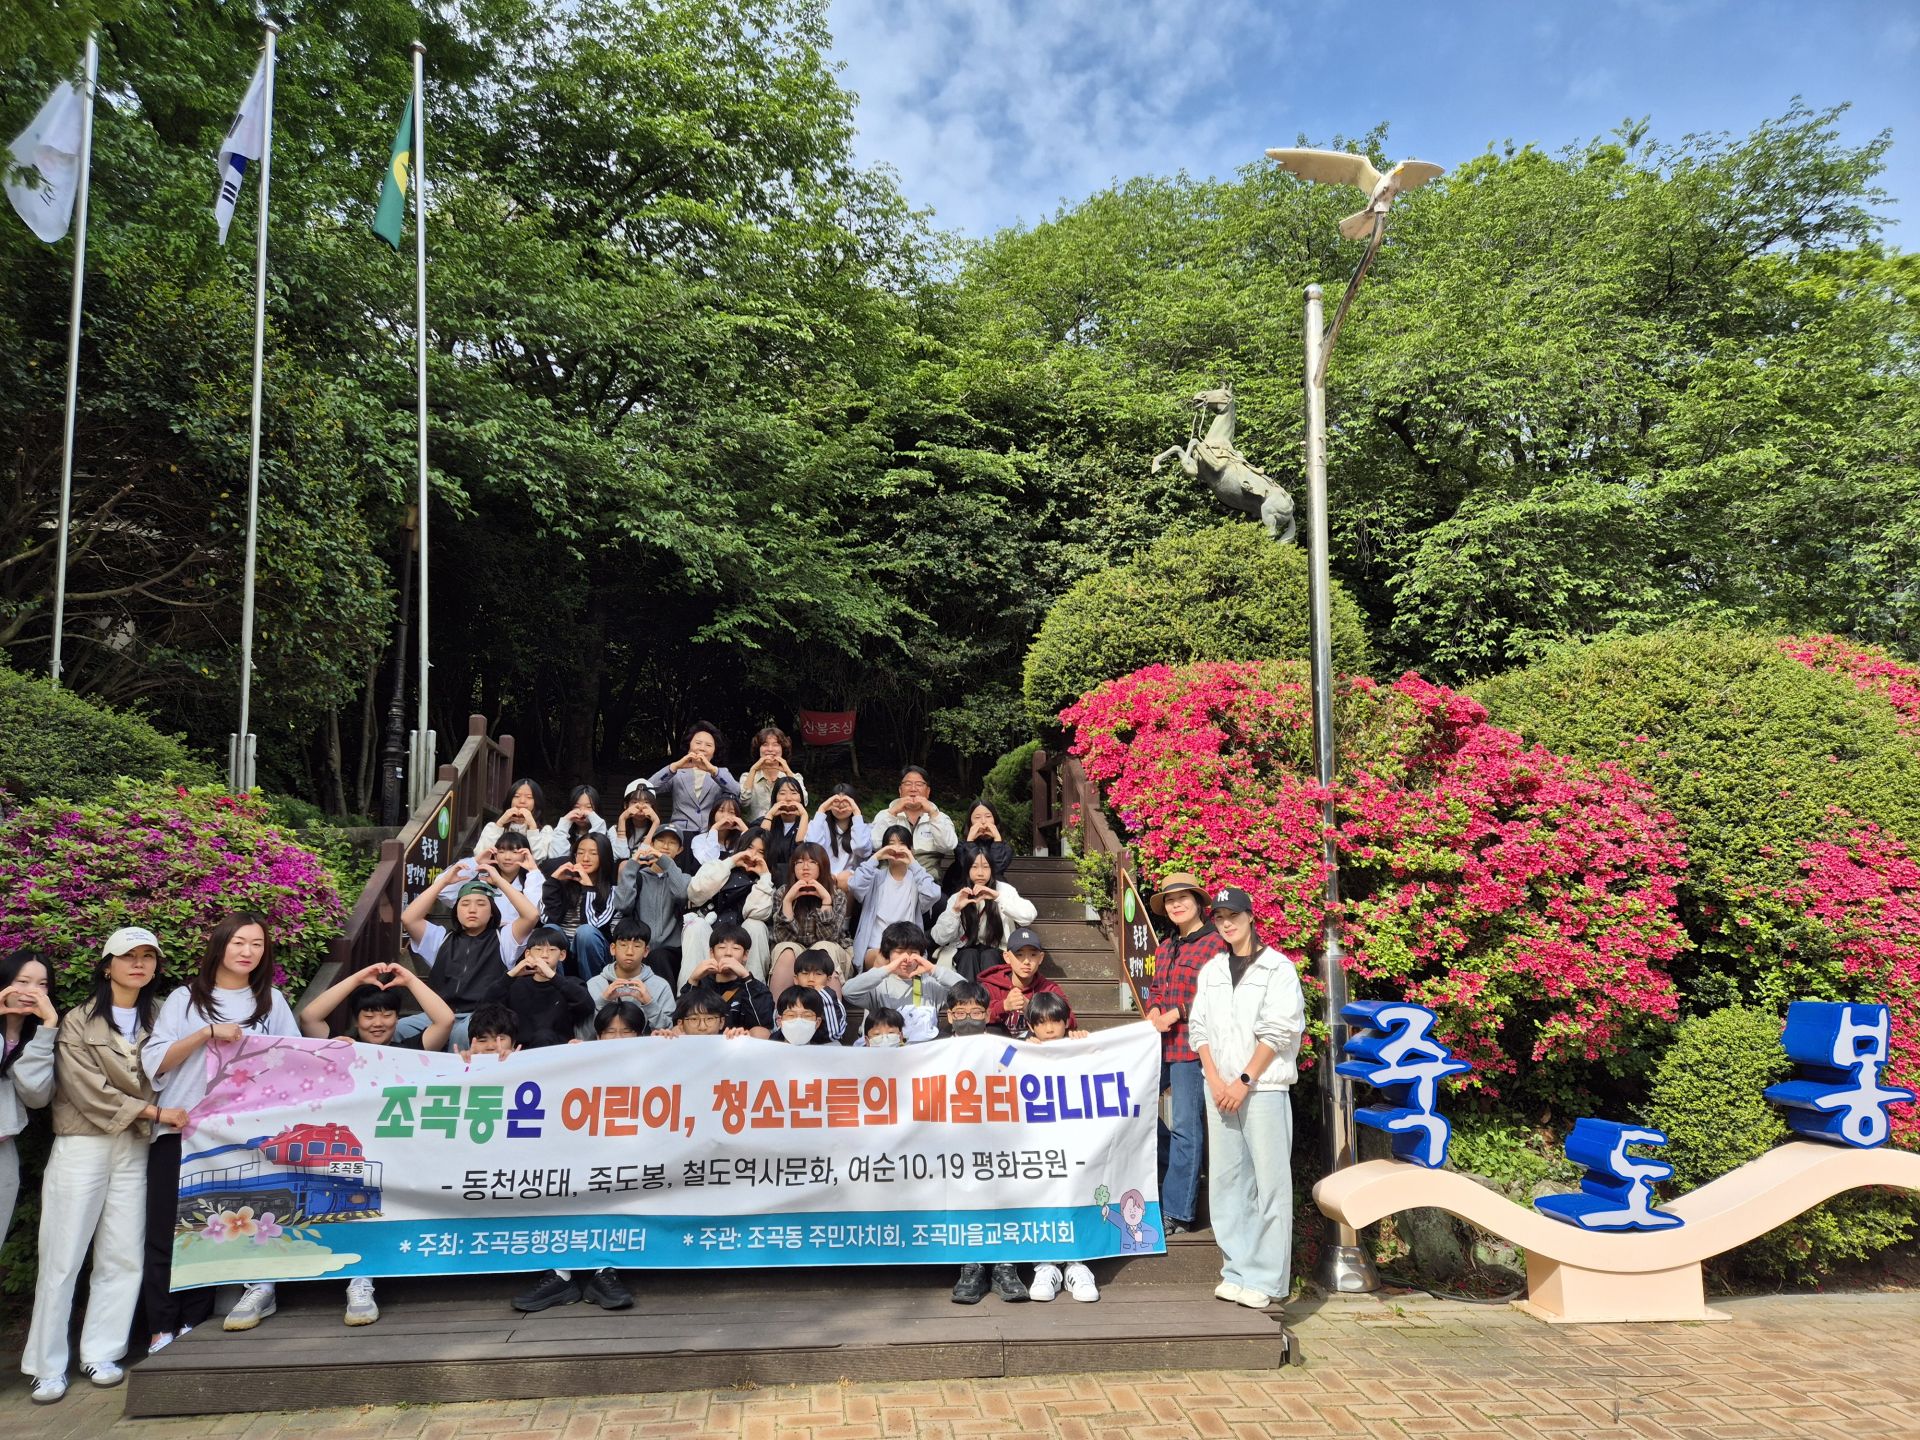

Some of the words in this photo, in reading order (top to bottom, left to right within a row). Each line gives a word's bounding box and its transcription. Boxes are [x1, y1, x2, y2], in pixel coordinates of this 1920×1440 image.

[803, 720, 852, 736] 산불조심
[421, 836, 439, 863] 죽도봉
[406, 863, 427, 886] 팔각정
[1133, 924, 1148, 951] 죽도봉
[374, 1081, 545, 1144] 조곡동은
[561, 1084, 695, 1138] 어린이,
[712, 1076, 898, 1135] 청소년들의
[329, 1162, 364, 1174] 조곡동
[462, 1167, 578, 1201] 동천생태,
[587, 1163, 673, 1194] 죽도봉,
[683, 1156, 838, 1187] 철도역사문화,
[849, 1152, 965, 1183] 여순10.19
[972, 1149, 1068, 1182] 평화공원
[469, 1228, 647, 1256] 조곡동행정복지센터
[747, 1225, 803, 1249] 조곡동
[808, 1223, 906, 1249] 주민자치회,
[911, 1221, 1075, 1247] 조곡마을교육자치회
